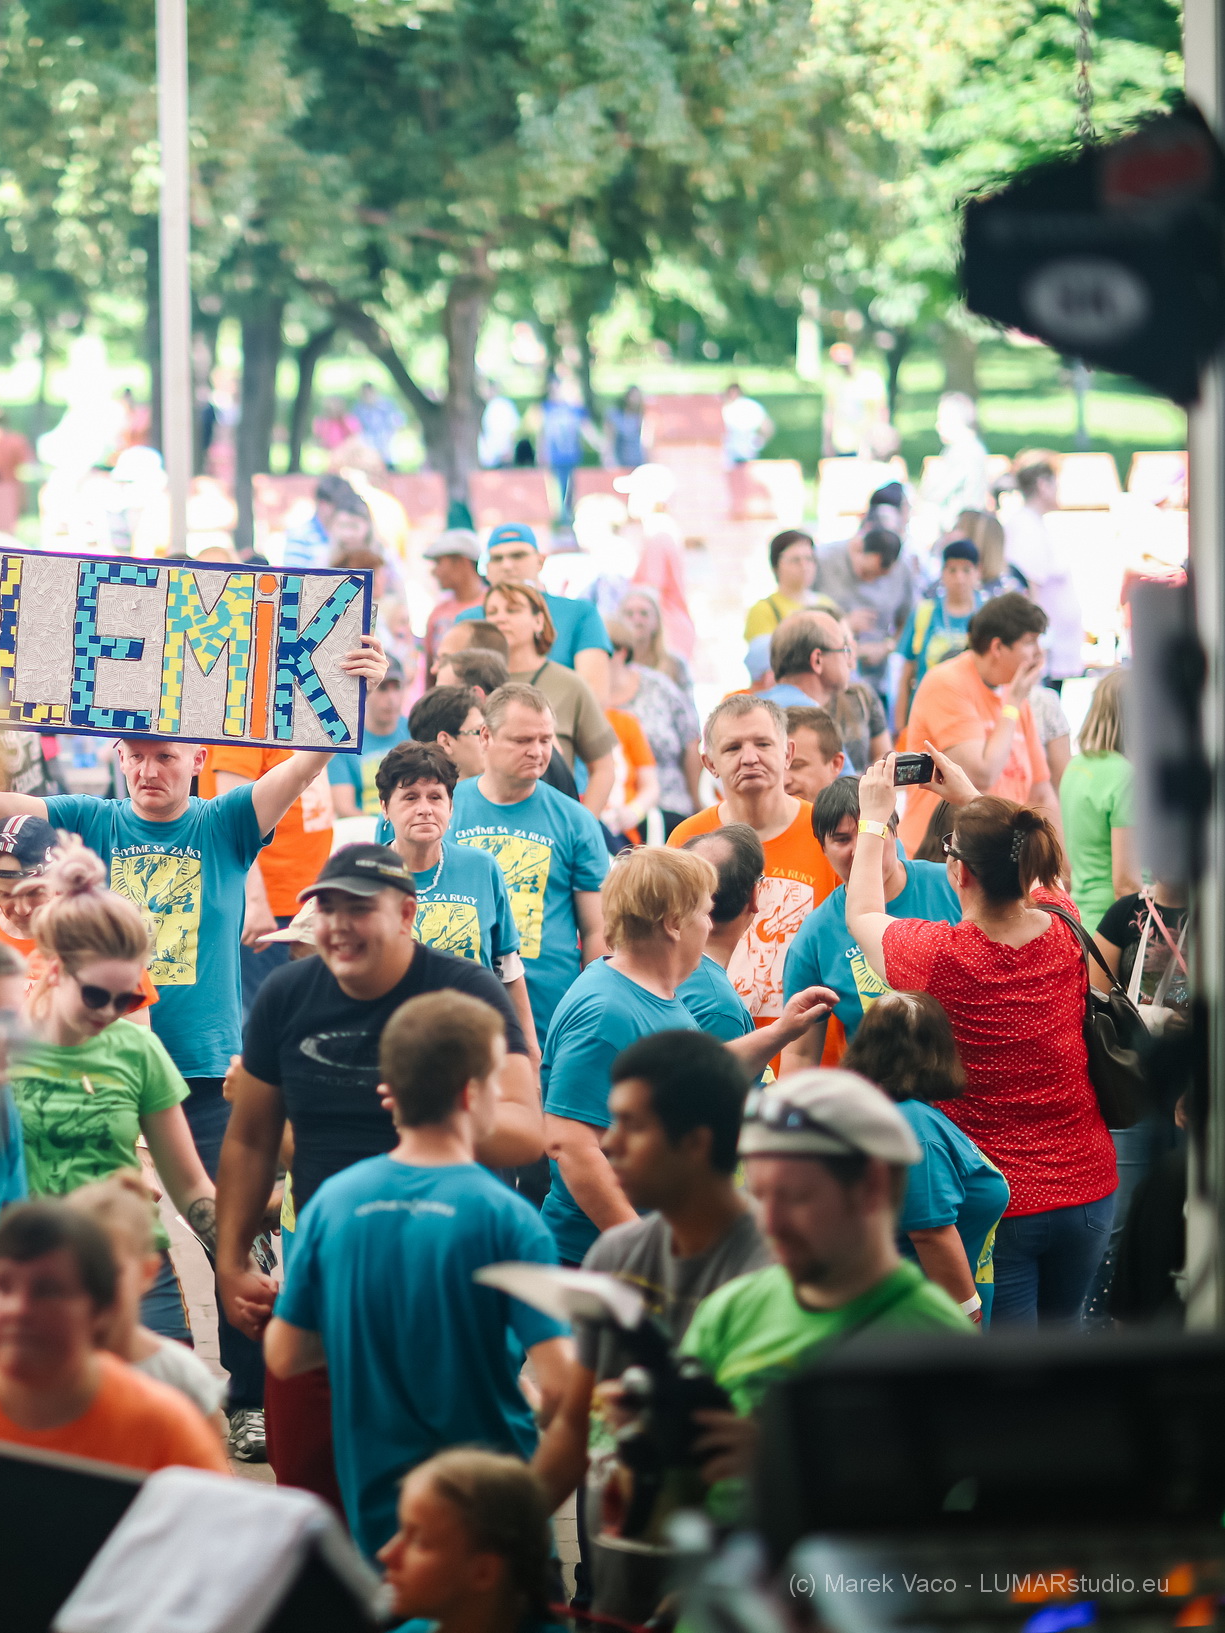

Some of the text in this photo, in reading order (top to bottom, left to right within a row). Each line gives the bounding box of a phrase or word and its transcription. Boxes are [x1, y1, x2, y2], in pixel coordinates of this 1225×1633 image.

[496, 826, 509, 835] SA
[513, 829, 527, 838] ZA
[528, 832, 555, 847] RUKY
[152, 845, 166, 853] SA
[170, 846, 184, 857] ZA
[771, 867, 816, 885] ZA RUKY
[433, 893, 448, 901] ZA
[449, 893, 478, 905] RUKY
